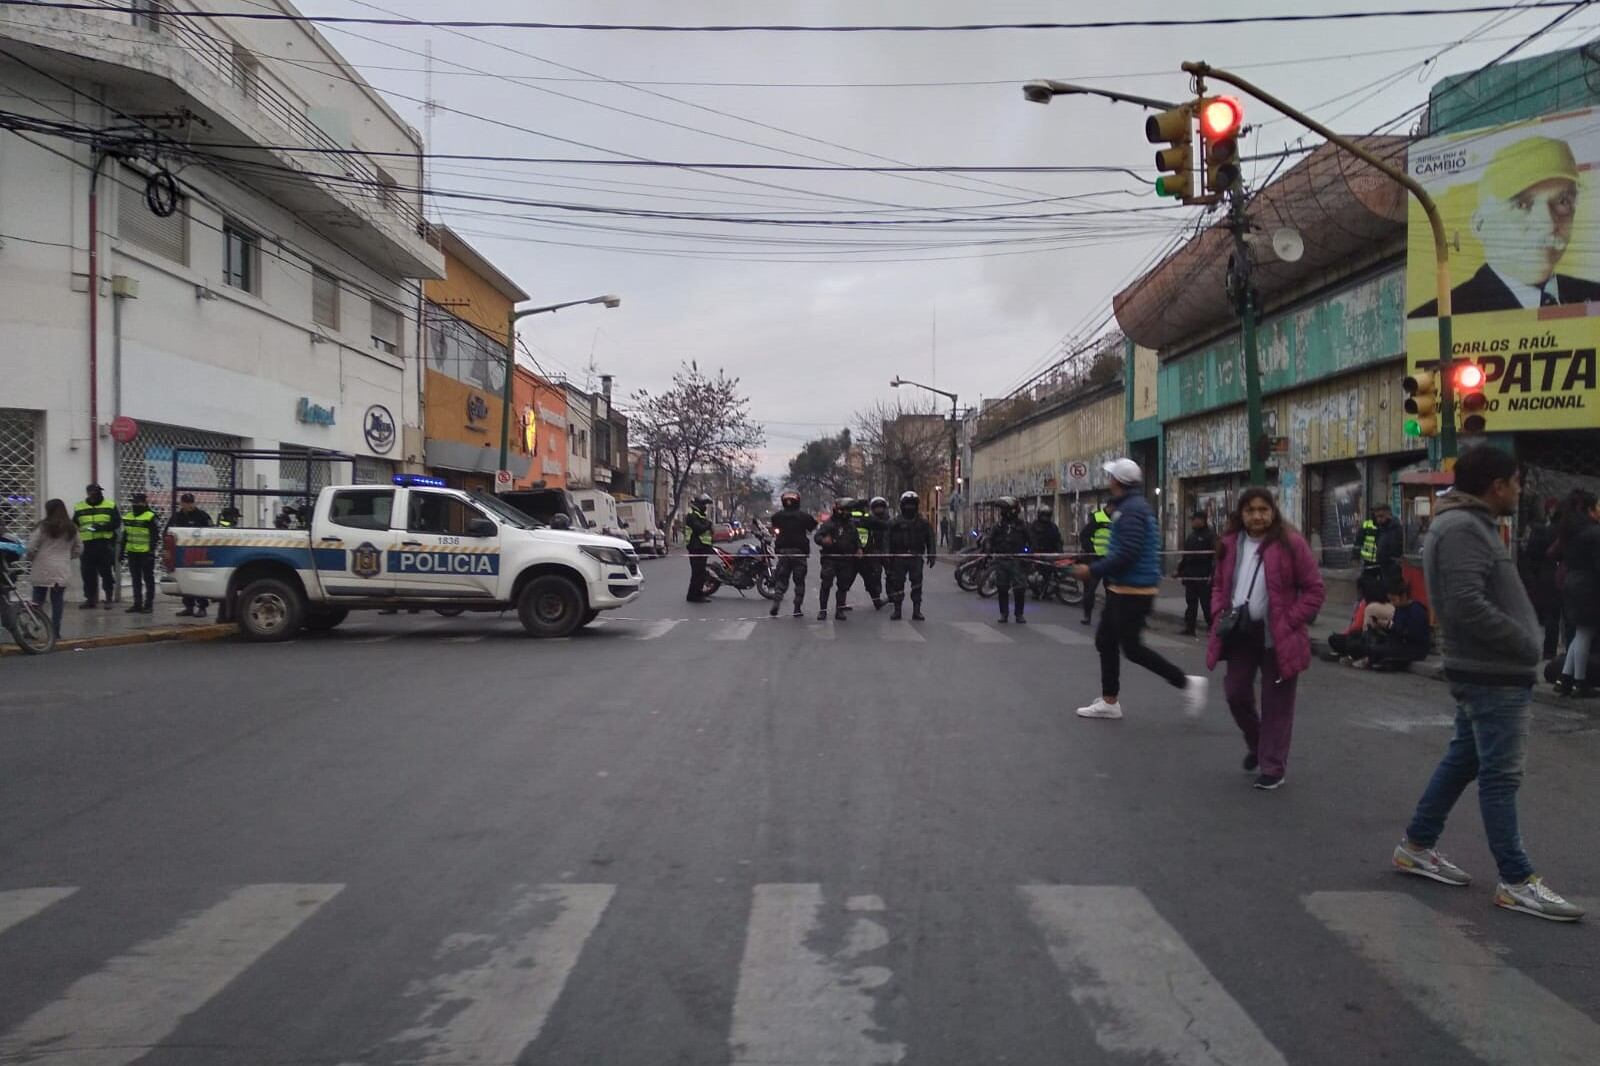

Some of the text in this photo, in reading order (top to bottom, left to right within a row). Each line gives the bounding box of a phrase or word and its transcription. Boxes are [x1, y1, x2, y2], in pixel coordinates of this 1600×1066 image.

[1415, 157, 1466, 175] CAMBIO
[1453, 331, 1559, 354] CARLOS RAÚL
[1415, 348, 1597, 394] PATA
[1508, 394, 1585, 412] NACIONAL
[401, 553, 493, 573] POLICIA
